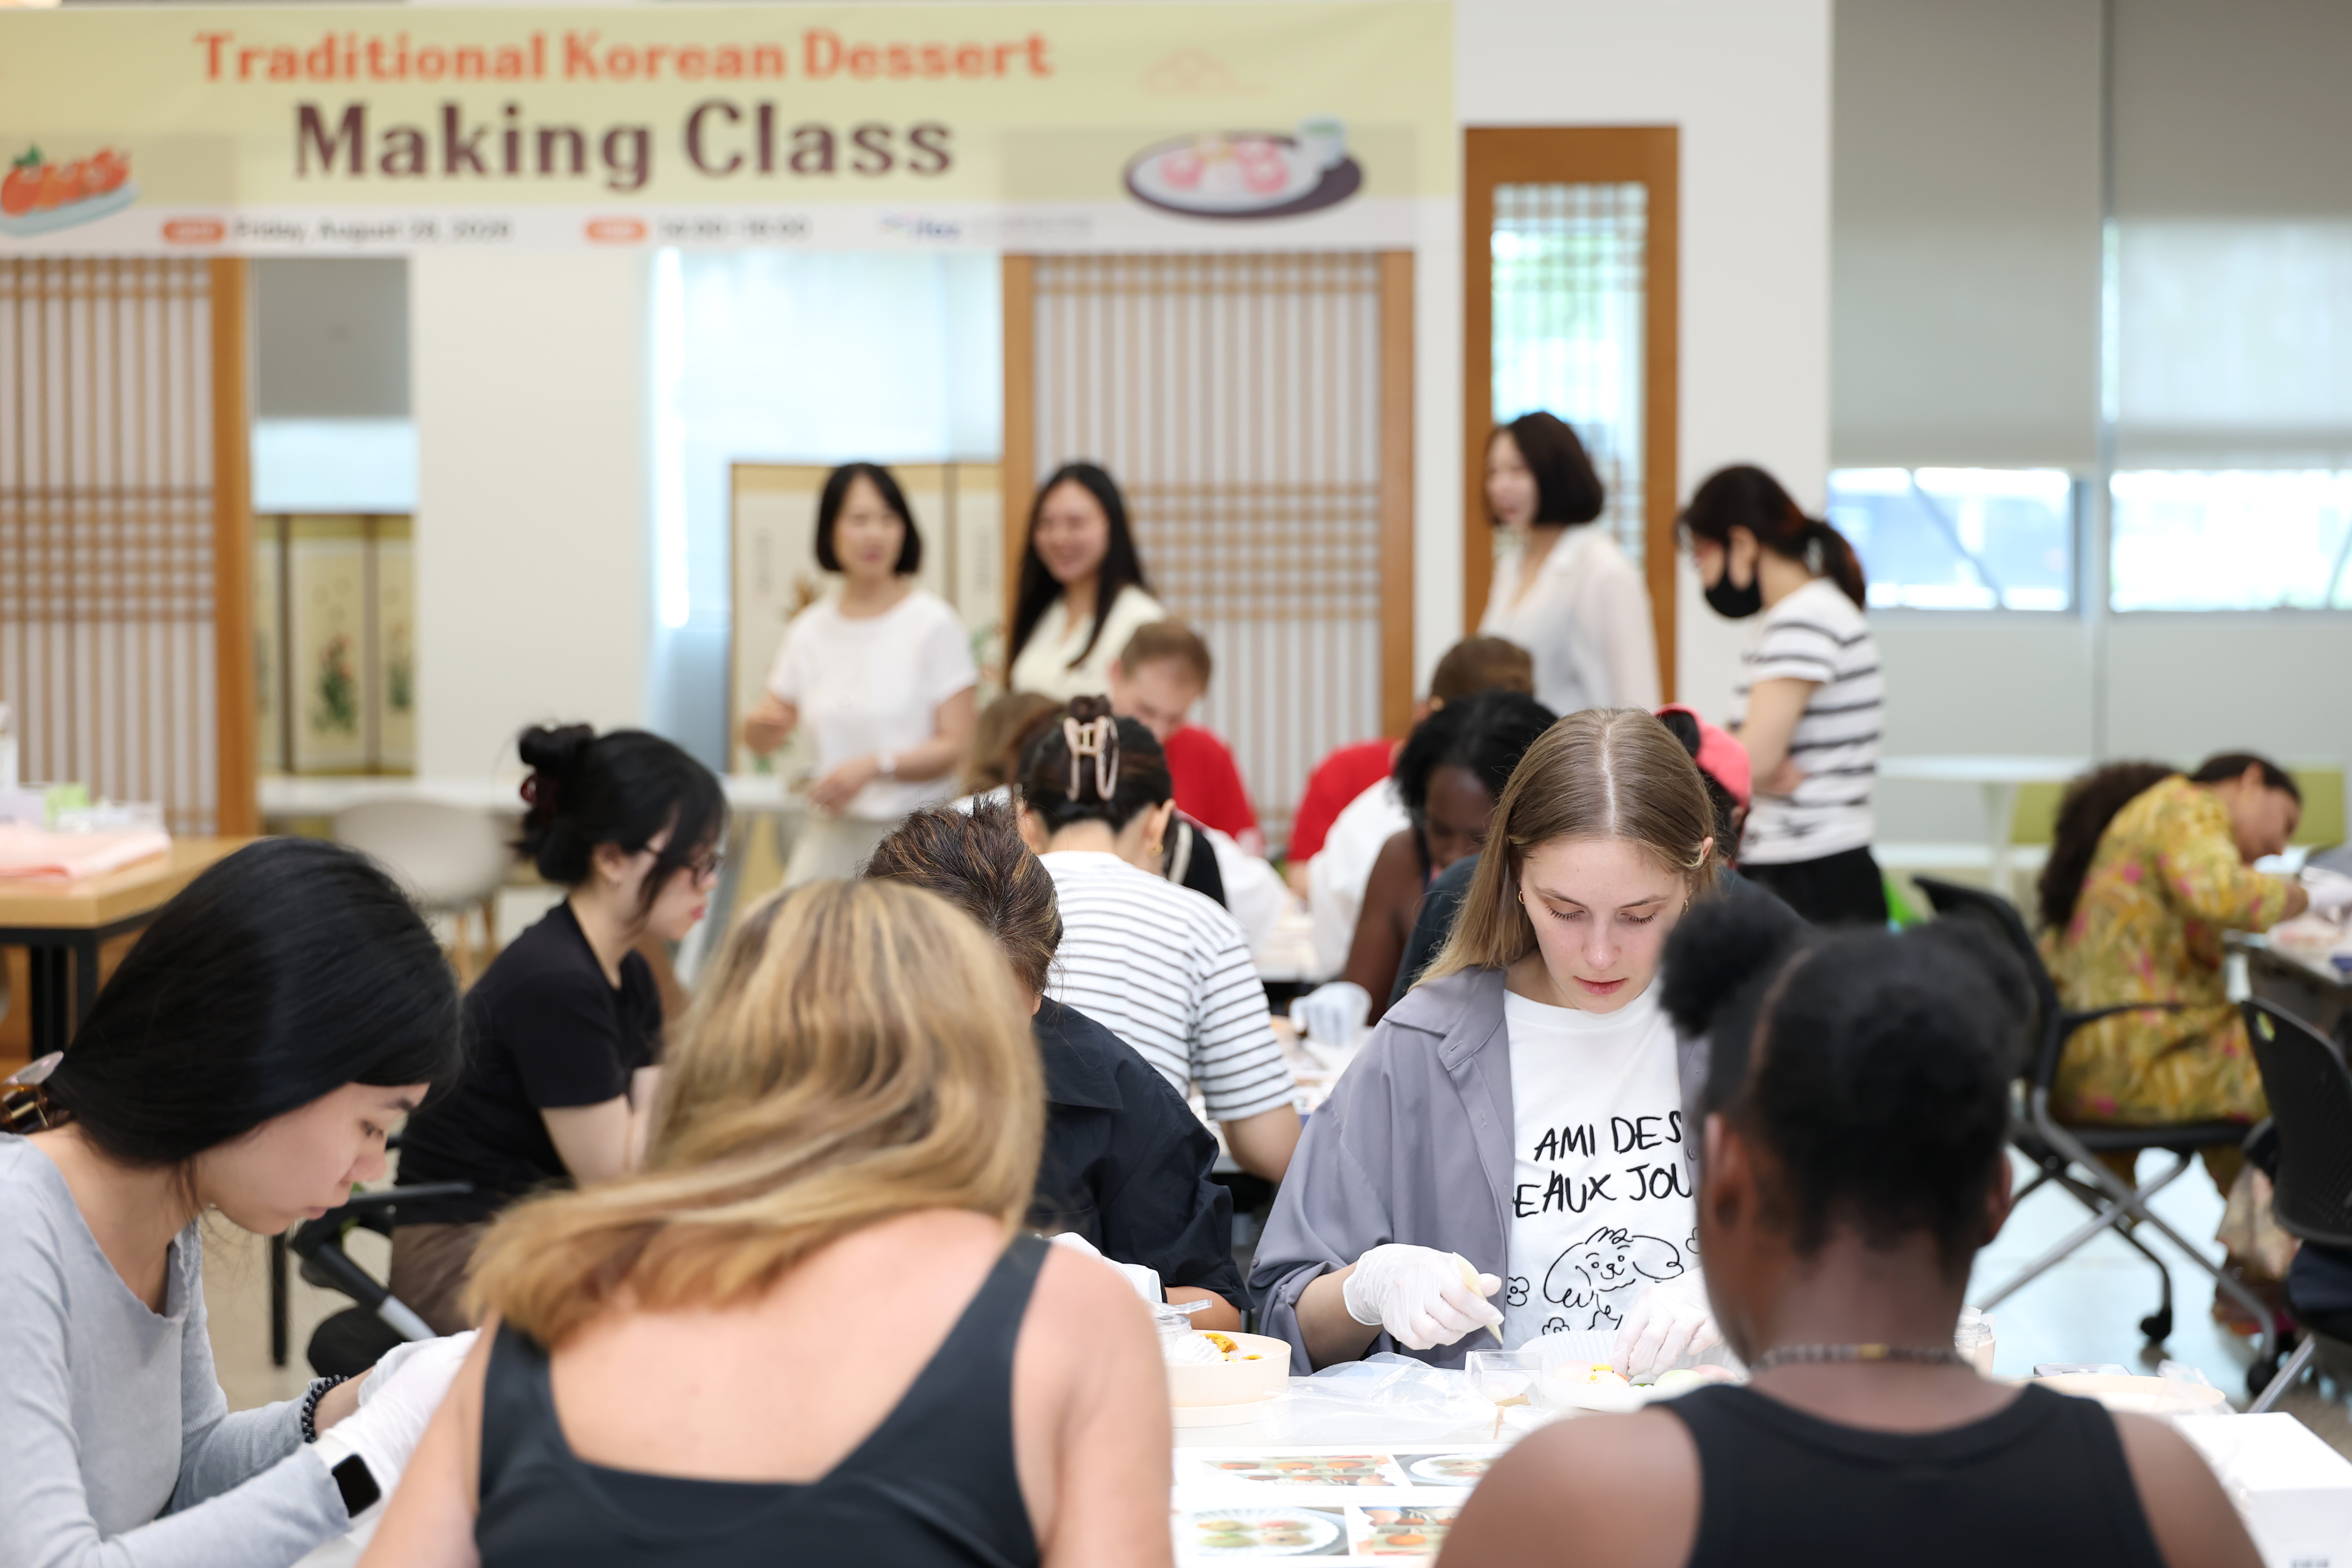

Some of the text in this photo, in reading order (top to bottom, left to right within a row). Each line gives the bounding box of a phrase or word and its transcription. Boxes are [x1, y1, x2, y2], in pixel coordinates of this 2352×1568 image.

[195, 30, 1049, 82] Traditional Korean Dessert
[292, 98, 953, 192] Making Class
[1534, 1110, 1682, 1162] AMI DES
[1512, 1170, 1617, 1218] EAUX
